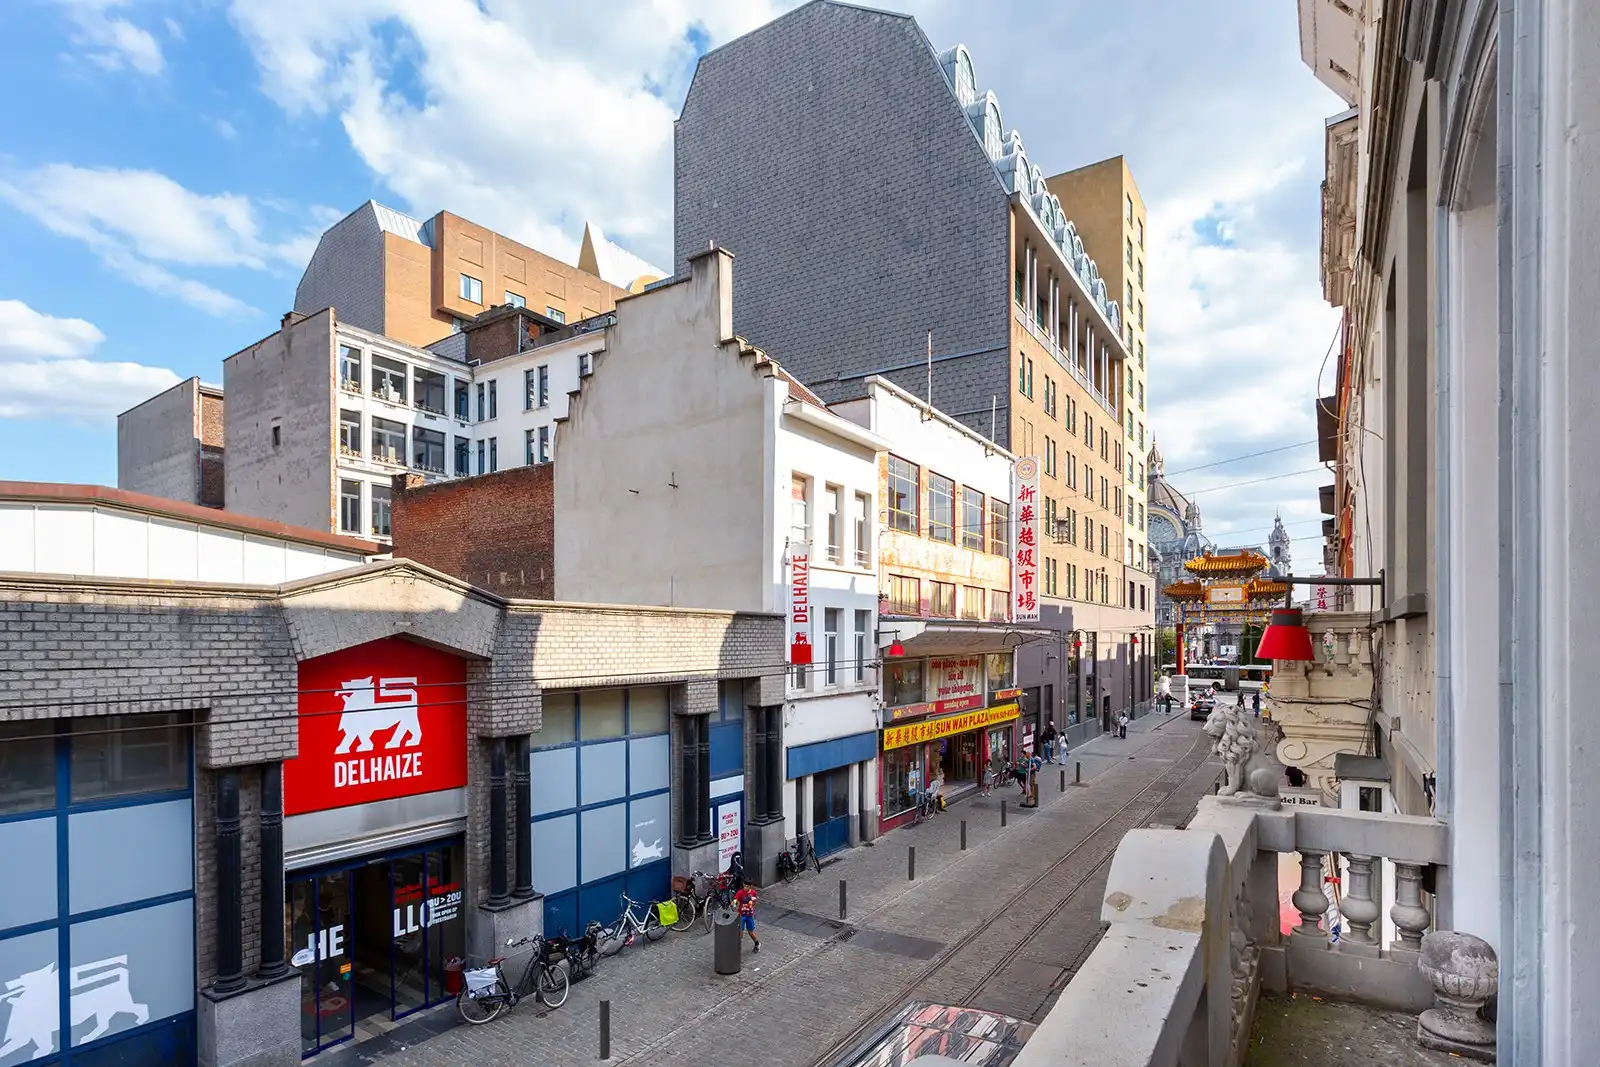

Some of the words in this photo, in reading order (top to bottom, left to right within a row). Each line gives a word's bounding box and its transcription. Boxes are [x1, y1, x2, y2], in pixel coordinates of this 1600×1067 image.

[1017, 484, 1036, 611] 新華超級市場
[793, 554, 808, 623] DELHAIZE
[951, 683, 974, 694] shopping
[935, 720, 950, 734] SUN
[952, 717, 967, 730] WAH
[968, 712, 989, 727] PLAZA
[334, 752, 423, 788] DELHAIZE
[446, 891, 462, 902] 20U
